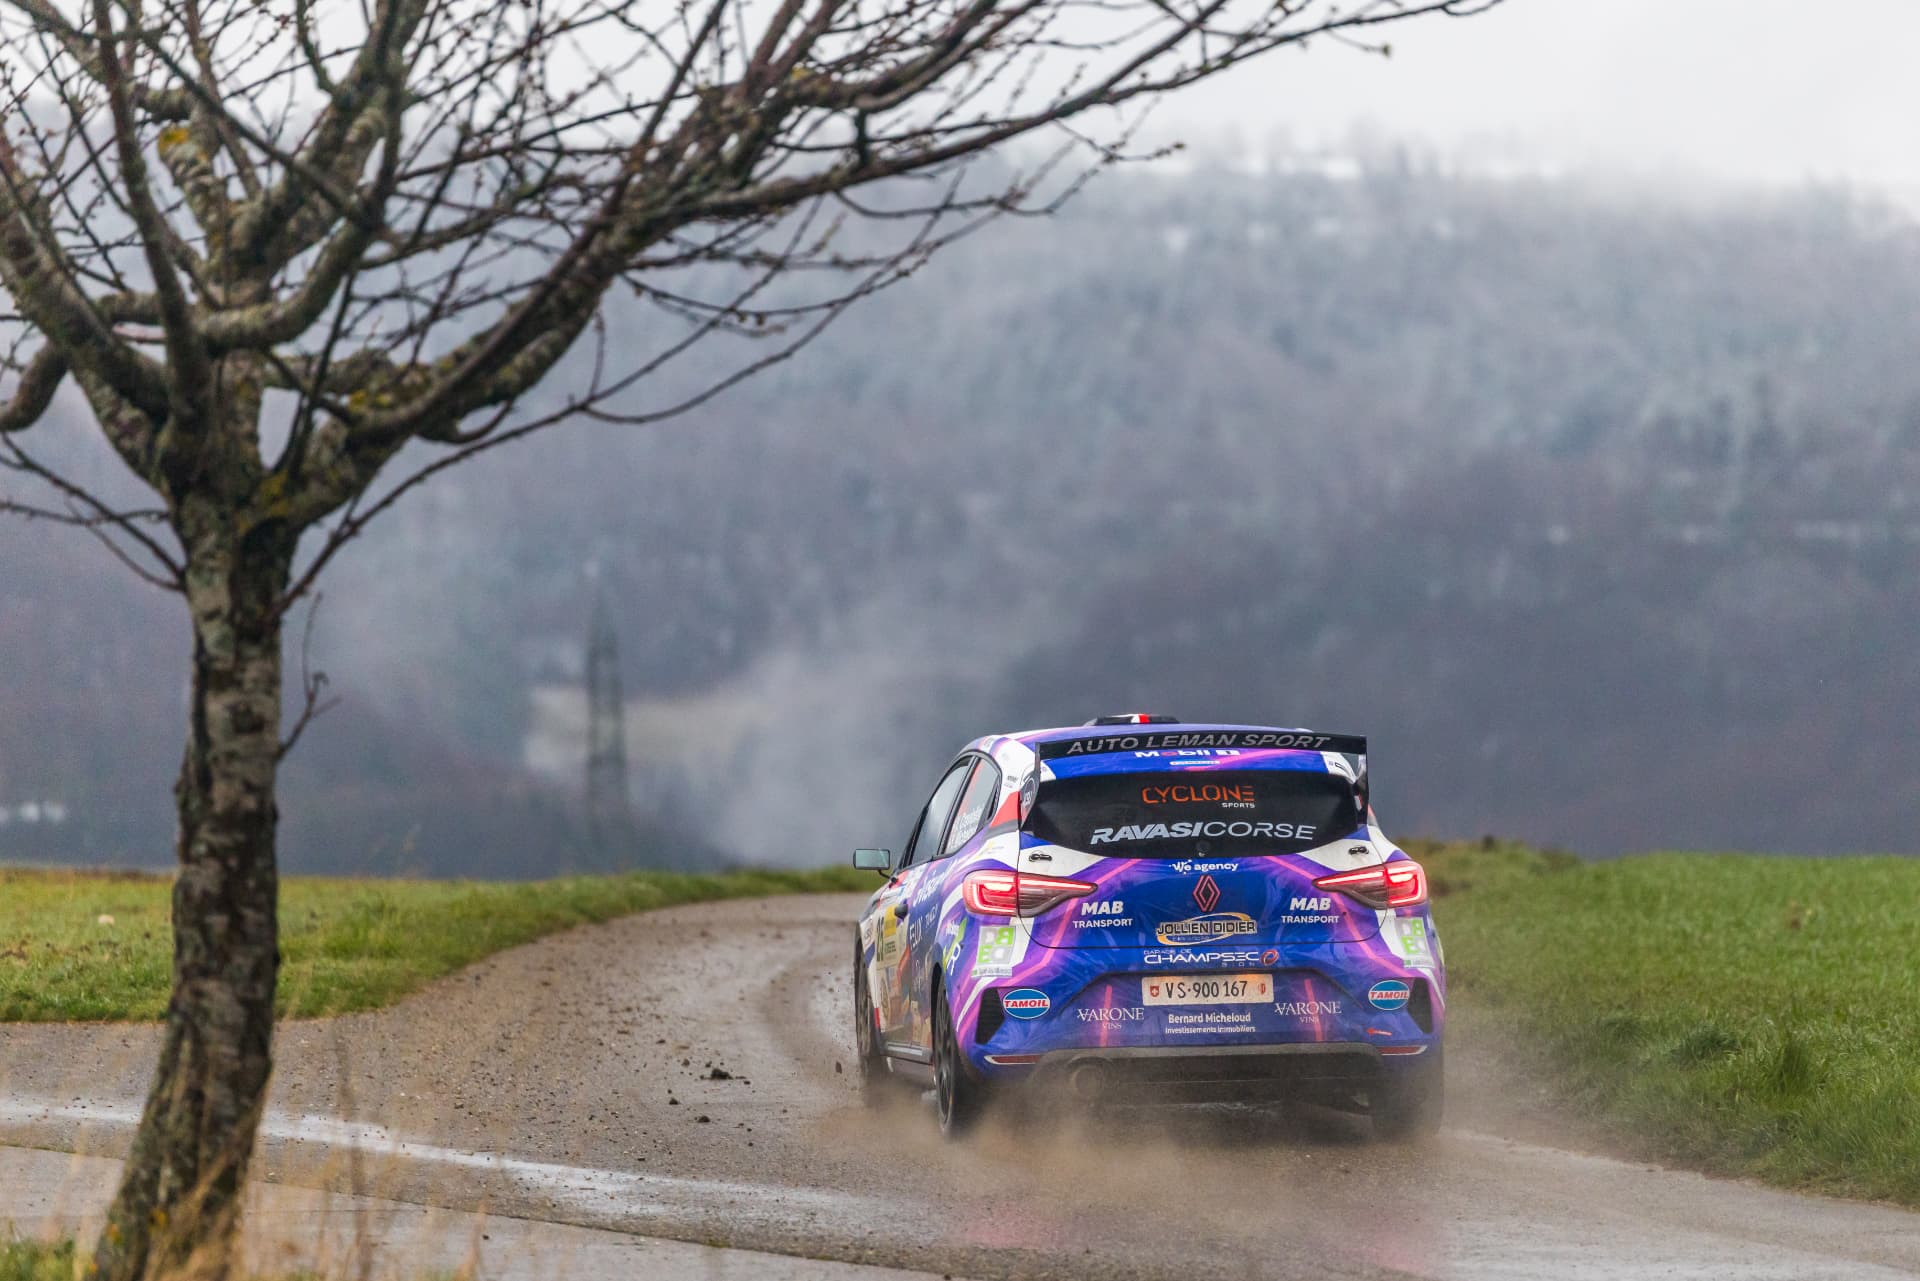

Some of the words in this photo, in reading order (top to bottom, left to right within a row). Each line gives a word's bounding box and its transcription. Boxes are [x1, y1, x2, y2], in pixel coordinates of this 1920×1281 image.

[1066, 737, 1139, 754] AUTO
[1146, 734, 1237, 748] LEMAN
[1242, 734, 1331, 748] SPORT
[1135, 749, 1210, 758] Mobil
[1142, 784, 1255, 804] CYCLONE
[1194, 863, 1239, 872] agency
[1081, 901, 1124, 916] MAB
[1289, 897, 1331, 911] MAB
[1072, 918, 1133, 929] TRANSPORT
[1281, 915, 1340, 924] TRANSPORT
[1157, 921, 1210, 935] JOLLIEN
[1213, 921, 1256, 933] DIDIER
[1143, 951, 1260, 964] CHAMPSEC
[1223, 980, 1248, 997] 167
[1370, 991, 1409, 999] TAMOIL
[1003, 999, 1049, 1008] TAMOIL
[1274, 1001, 1342, 1016] VARONE
[1077, 1007, 1145, 1022] VARONE
[1168, 1012, 1204, 1024] Bernard
[1205, 1011, 1251, 1023] Micheloud
[1299, 1016, 1320, 1025] VINS
[1101, 1022, 1122, 1030] VINS
